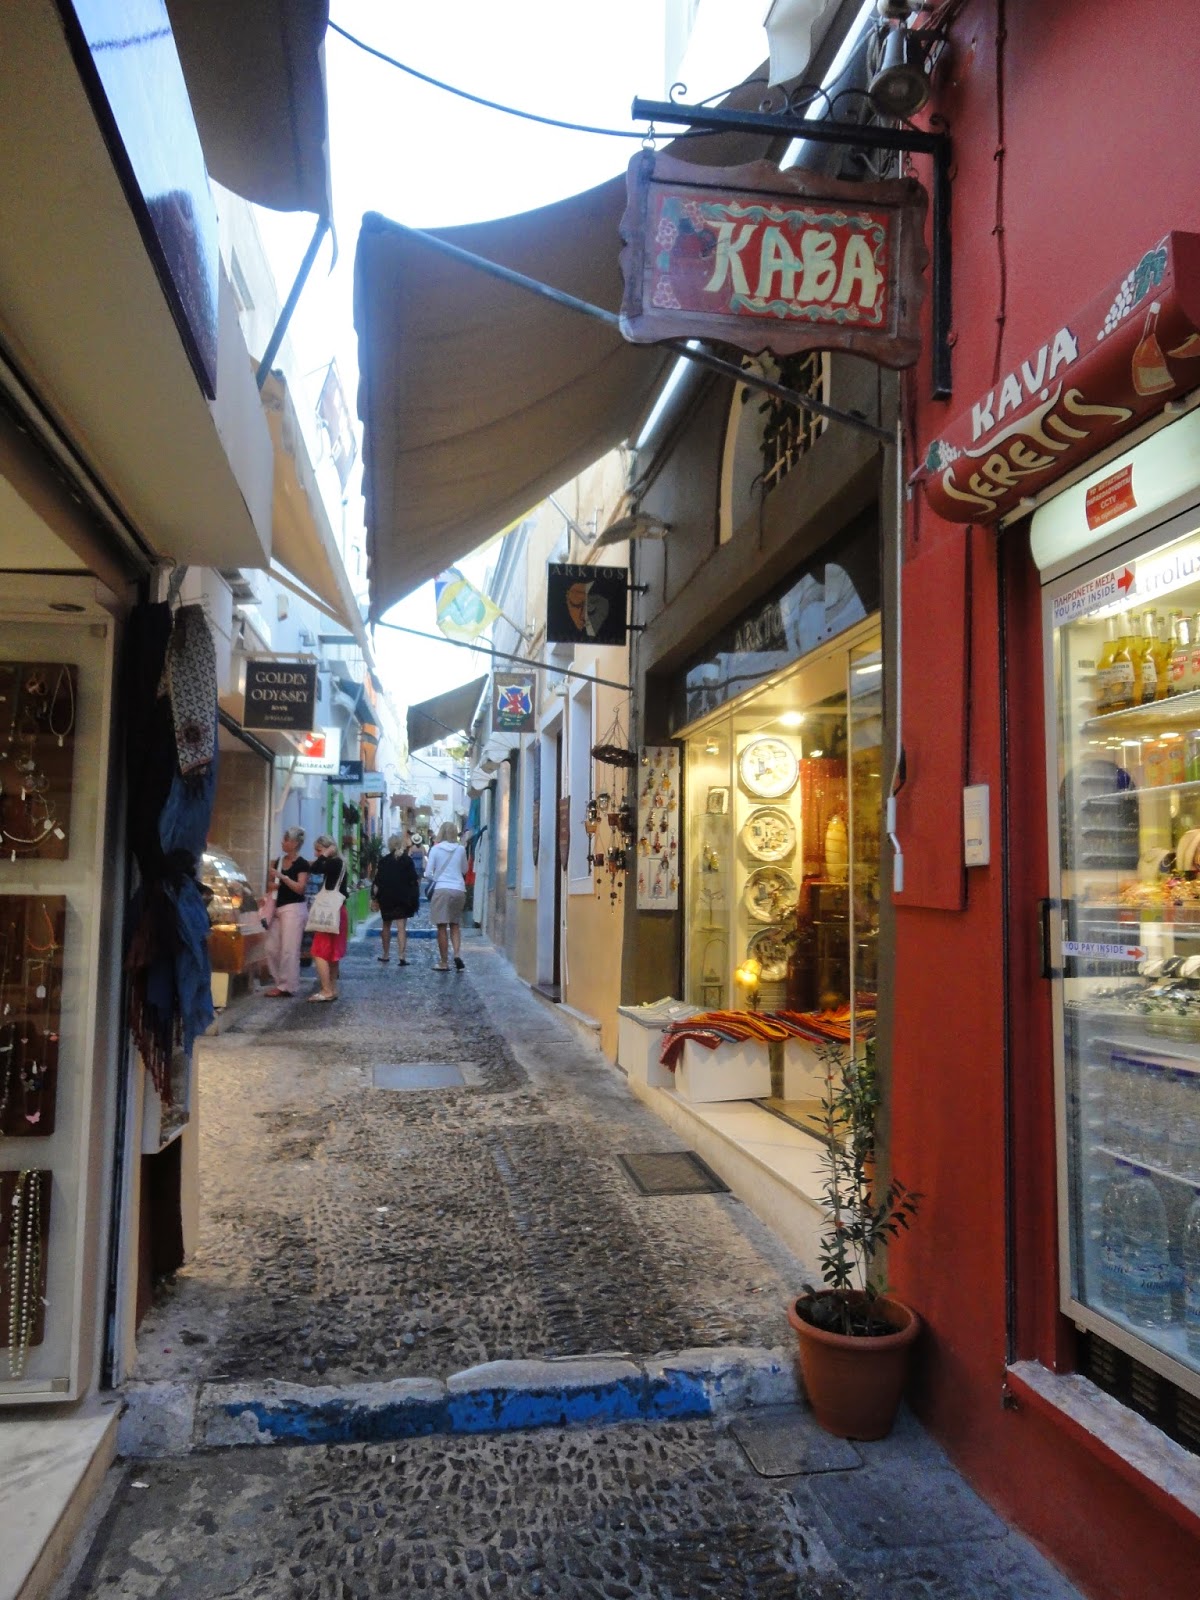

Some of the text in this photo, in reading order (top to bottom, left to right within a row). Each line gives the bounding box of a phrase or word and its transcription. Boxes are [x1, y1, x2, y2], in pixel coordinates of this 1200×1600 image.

[971, 327, 1078, 442] KAVA
[1100, 494, 1117, 509] CCTV
[1054, 583, 1116, 619] YOU PAY INSIDE
[735, 603, 783, 653] ARKTO
[255, 671, 307, 684] GOLDEN
[251, 689, 308, 702] ODYSSEY
[1081, 943, 1095, 952] PAY
[1097, 944, 1124, 954] INSIDE
